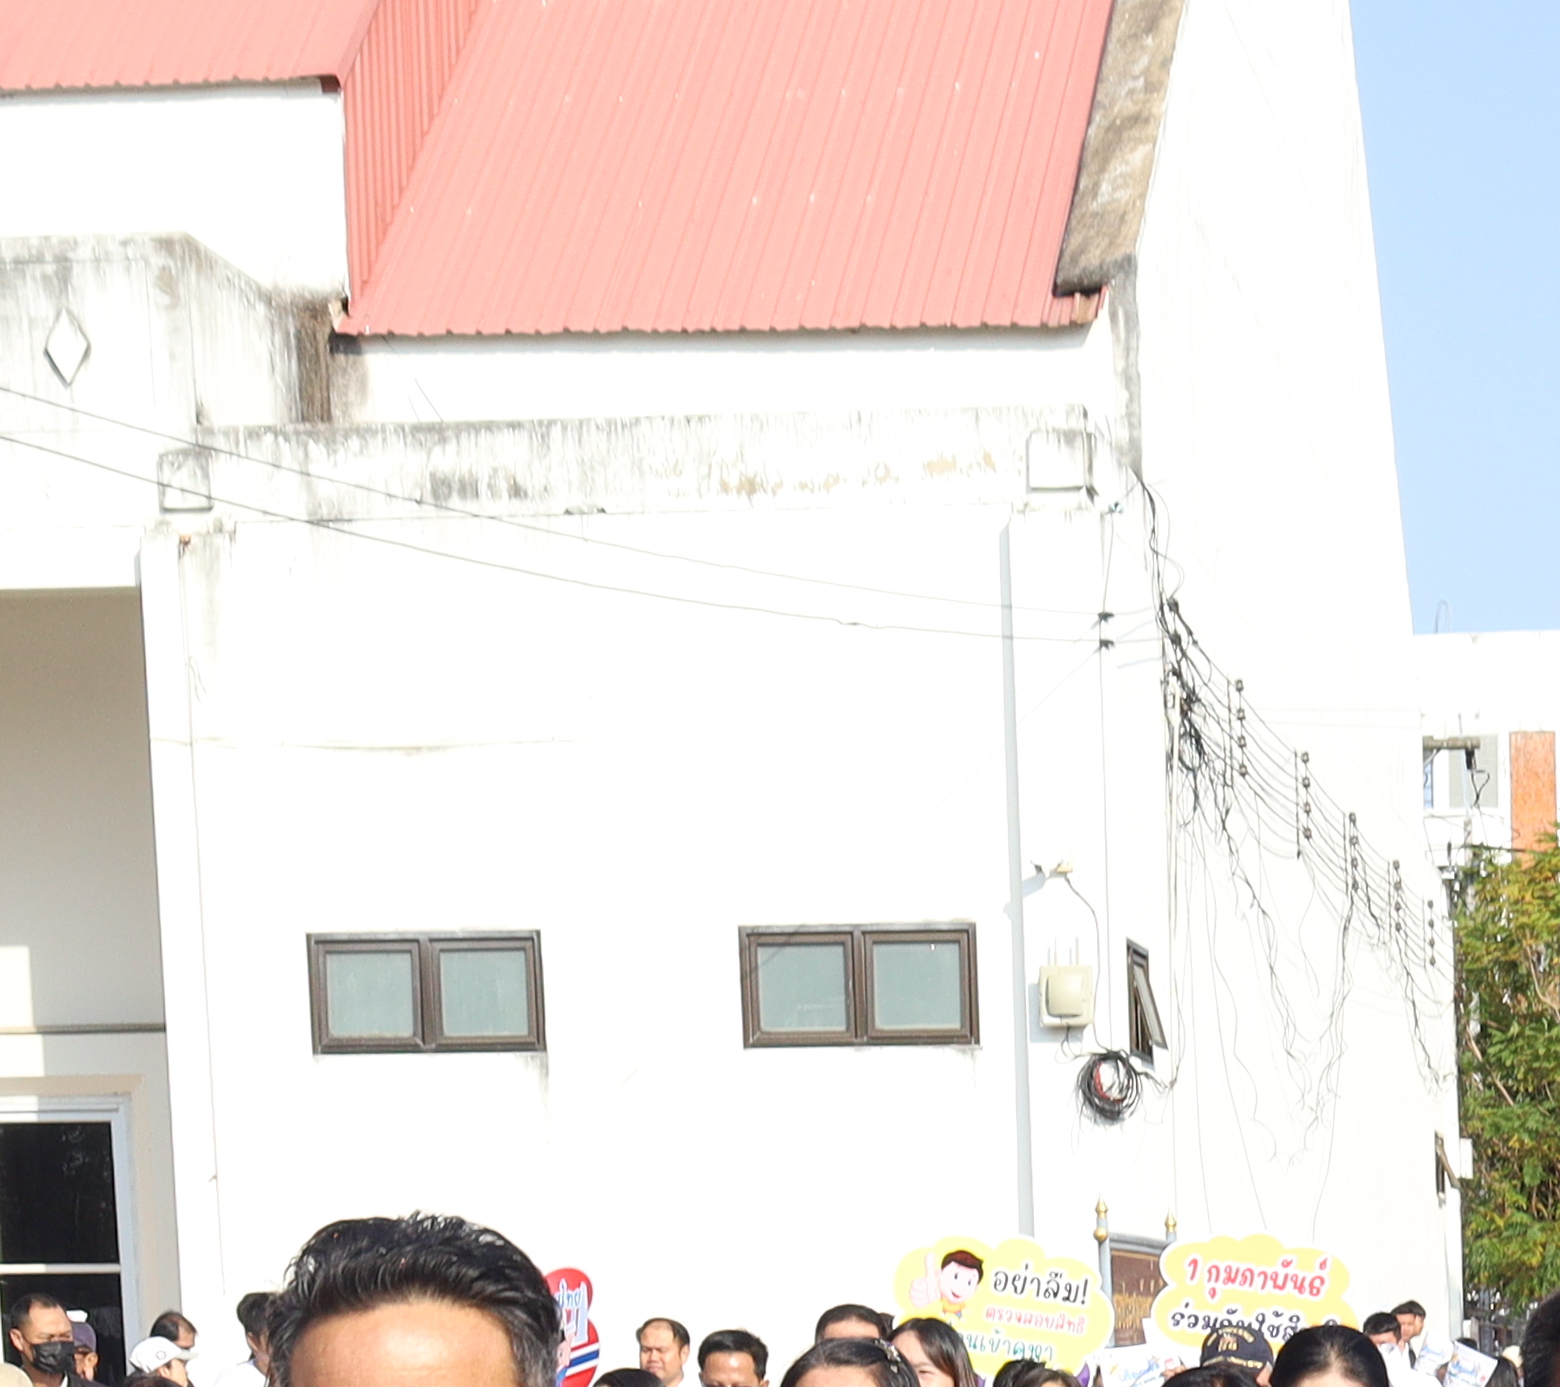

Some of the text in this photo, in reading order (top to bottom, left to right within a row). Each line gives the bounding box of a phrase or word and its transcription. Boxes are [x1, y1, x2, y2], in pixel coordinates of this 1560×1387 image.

[993, 1263, 1089, 1305] อย่าลืม!
[1188, 1257, 1325, 1299] 1 กุมภาพันธ์
